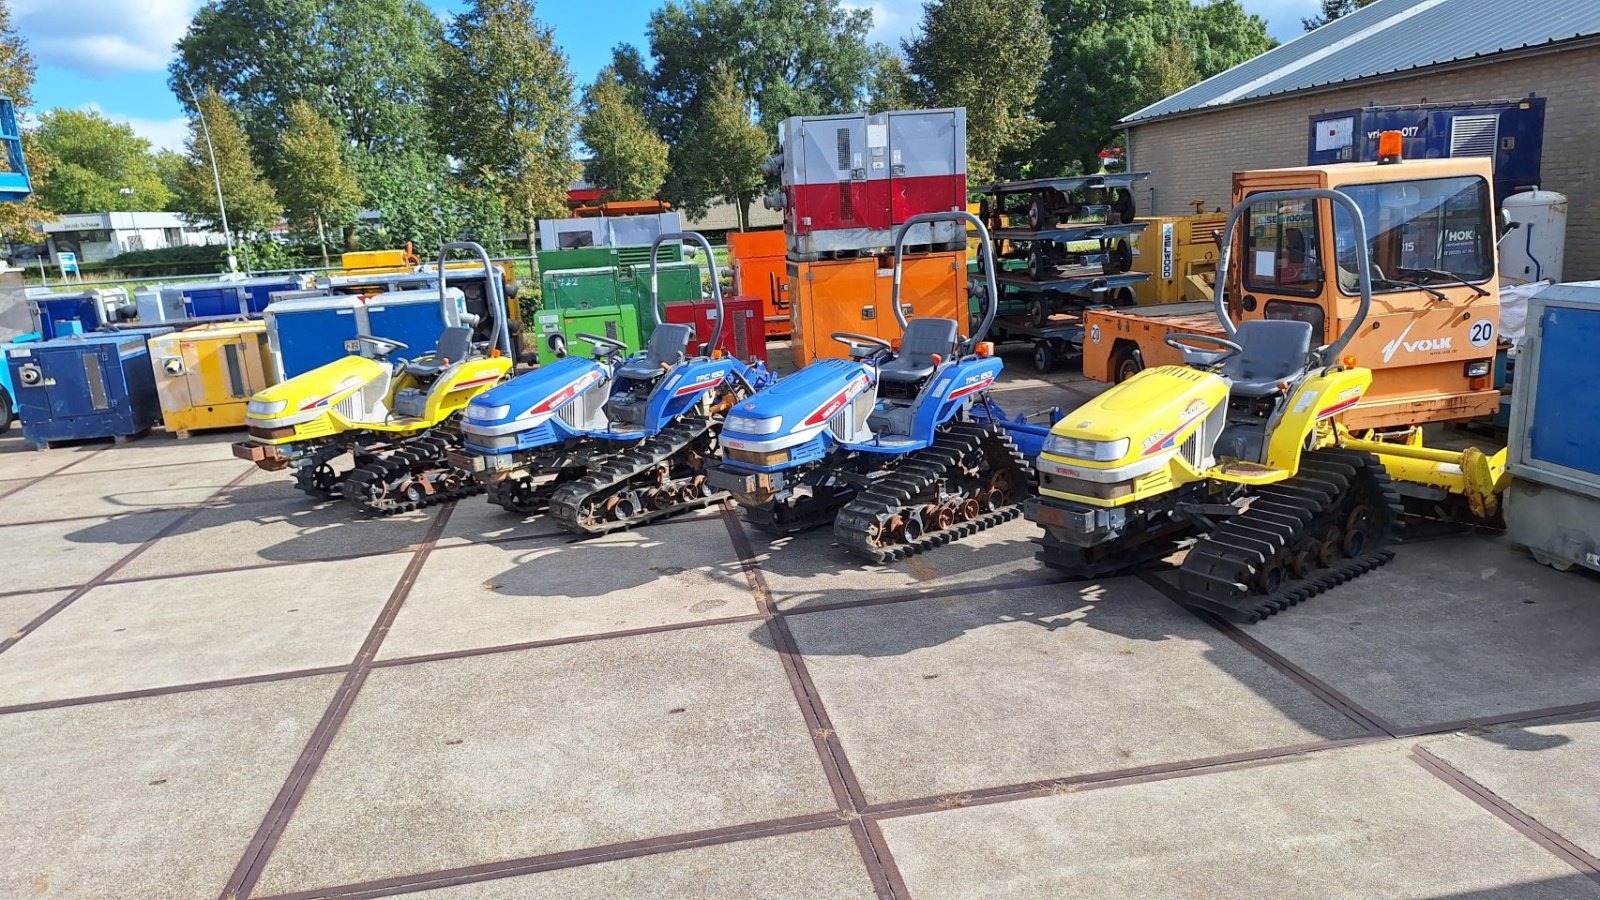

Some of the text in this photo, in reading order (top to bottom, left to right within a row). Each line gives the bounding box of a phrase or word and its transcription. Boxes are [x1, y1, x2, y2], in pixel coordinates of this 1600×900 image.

[1163, 234, 1172, 278] SELWOOD
[1092, 327, 1100, 340] 20
[1472, 322, 1492, 342] 20
[1402, 336, 1452, 353] VOLK
